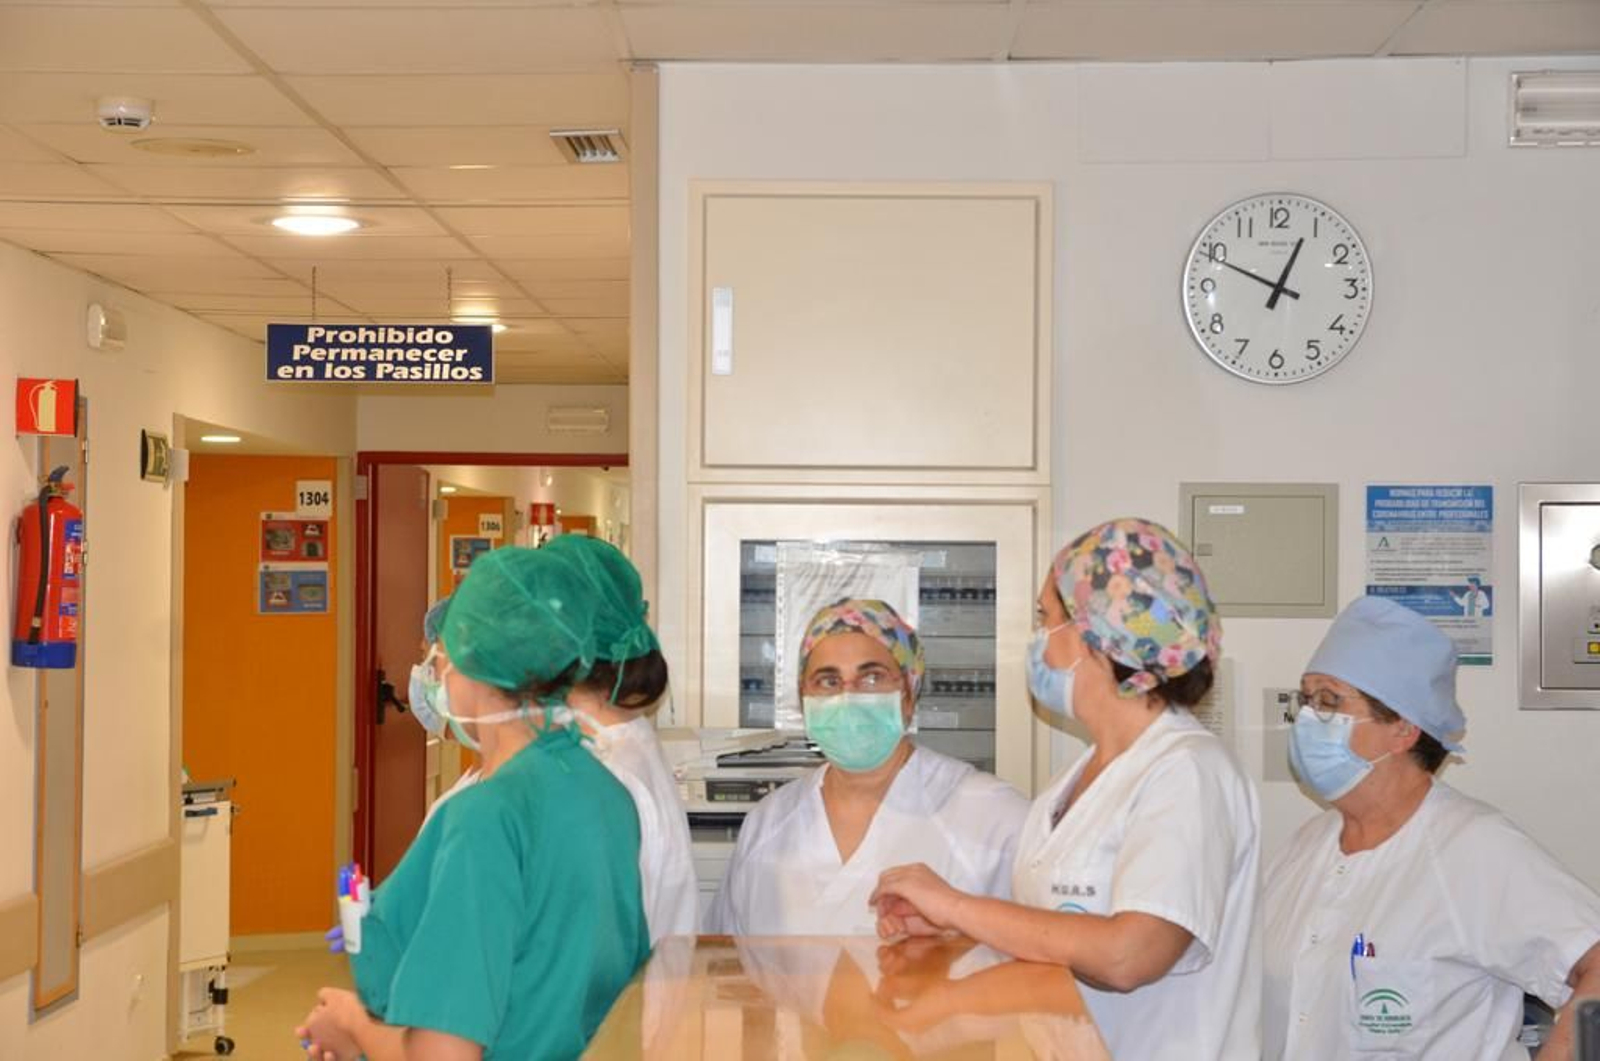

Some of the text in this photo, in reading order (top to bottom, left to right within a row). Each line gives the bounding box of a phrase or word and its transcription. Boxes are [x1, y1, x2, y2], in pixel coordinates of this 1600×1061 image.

[1236, 216, 1254, 238] 11
[1269, 206, 1291, 229] 12
[1208, 242, 1227, 263] 10
[1332, 243, 1350, 265] 2
[1343, 278, 1359, 299] 3
[1210, 313, 1224, 334] 8
[1328, 314, 1346, 335] 4
[306, 326, 454, 344] Prohibido
[292, 344, 468, 362] Permanecer
[1235, 339, 1251, 359] 7
[1268, 349, 1285, 370] 6
[1305, 340, 1321, 361] 5
[276, 363, 483, 380] en los Pasillos
[299, 491, 329, 506] 1304
